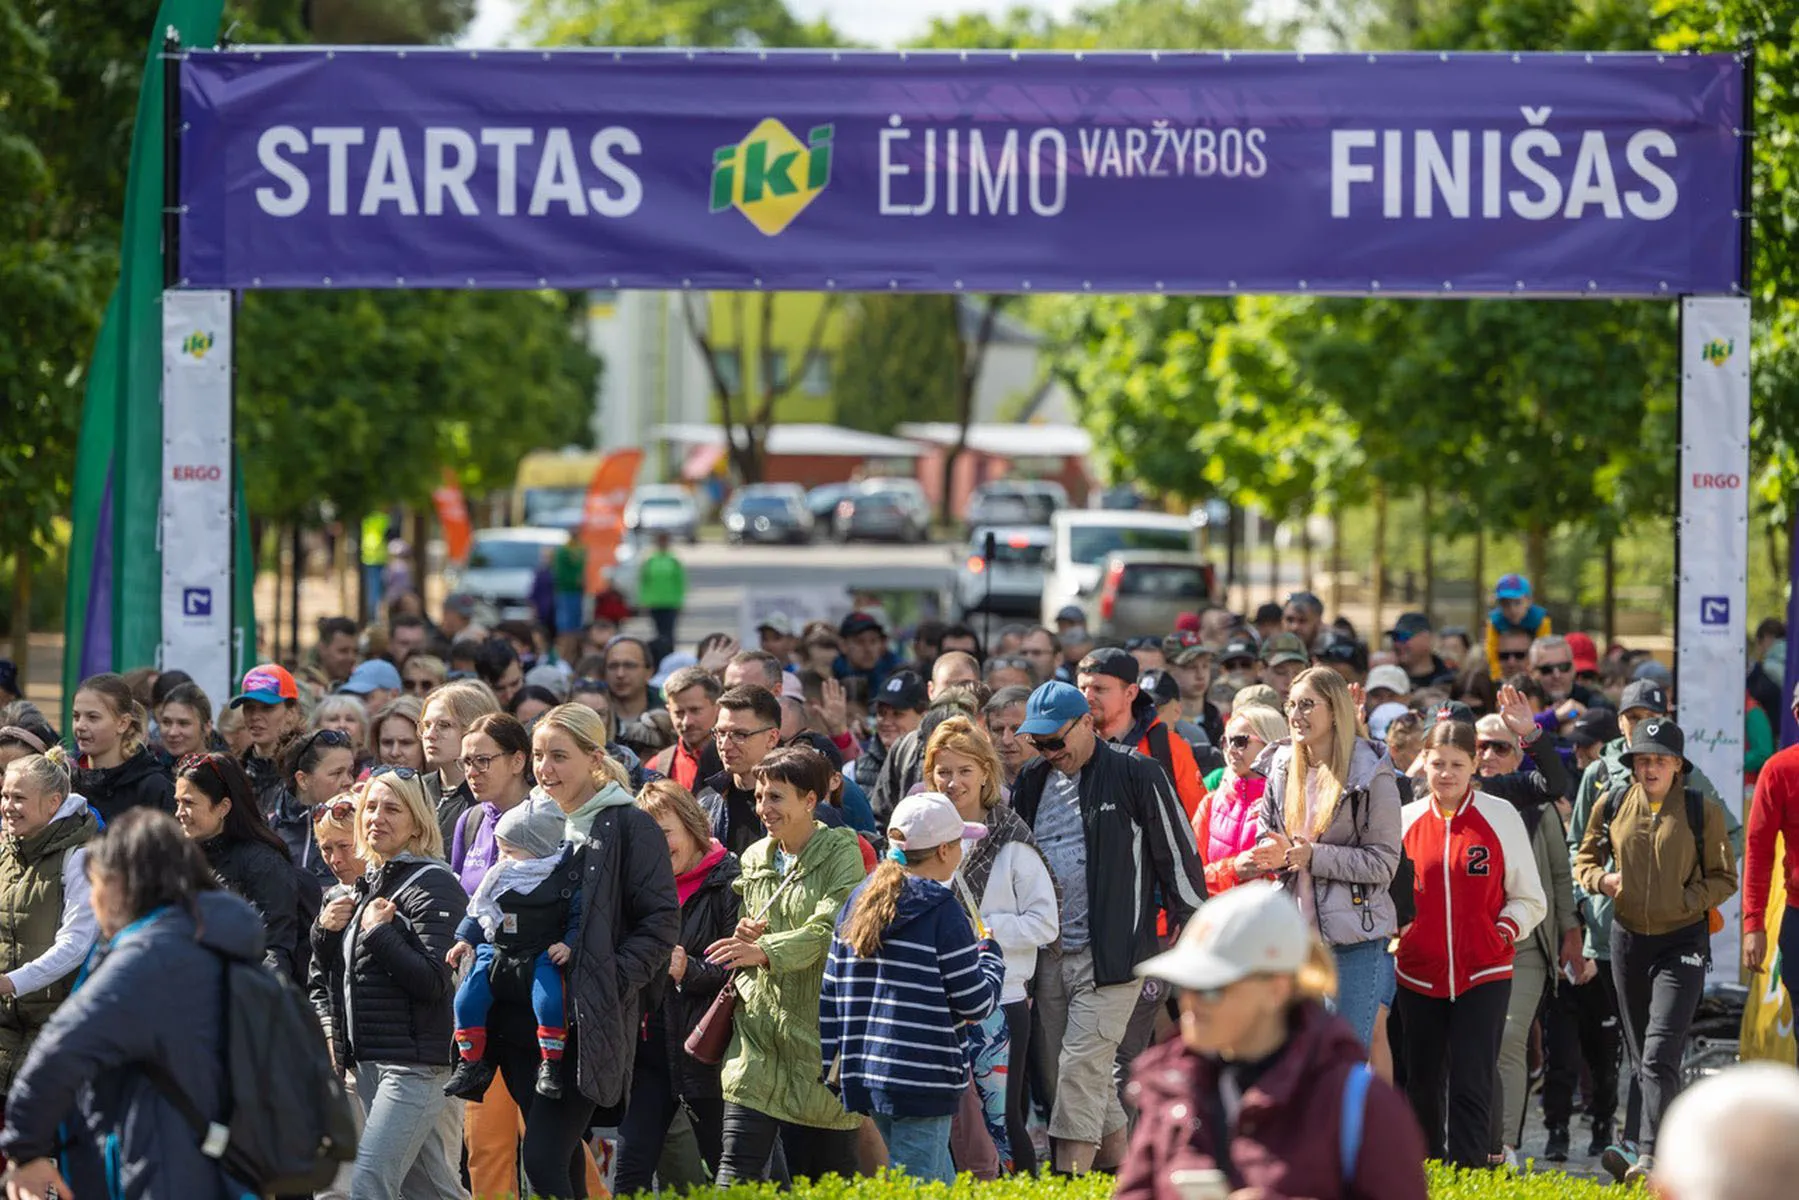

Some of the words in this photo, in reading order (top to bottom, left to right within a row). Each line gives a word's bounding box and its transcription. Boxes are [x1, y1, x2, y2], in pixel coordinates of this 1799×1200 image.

[256, 125, 643, 218] STARTAS
[709, 122, 835, 214] iki
[878, 113, 1067, 217] ĖJIMO
[1079, 119, 1268, 179] VARŽYBOS
[1330, 106, 1679, 221] FINIŠAS
[182, 331, 215, 355] iki
[1702, 337, 1735, 361] iki
[173, 464, 221, 481] ERGO
[1692, 473, 1741, 490] ERGO
[1467, 844, 1490, 876] 2
